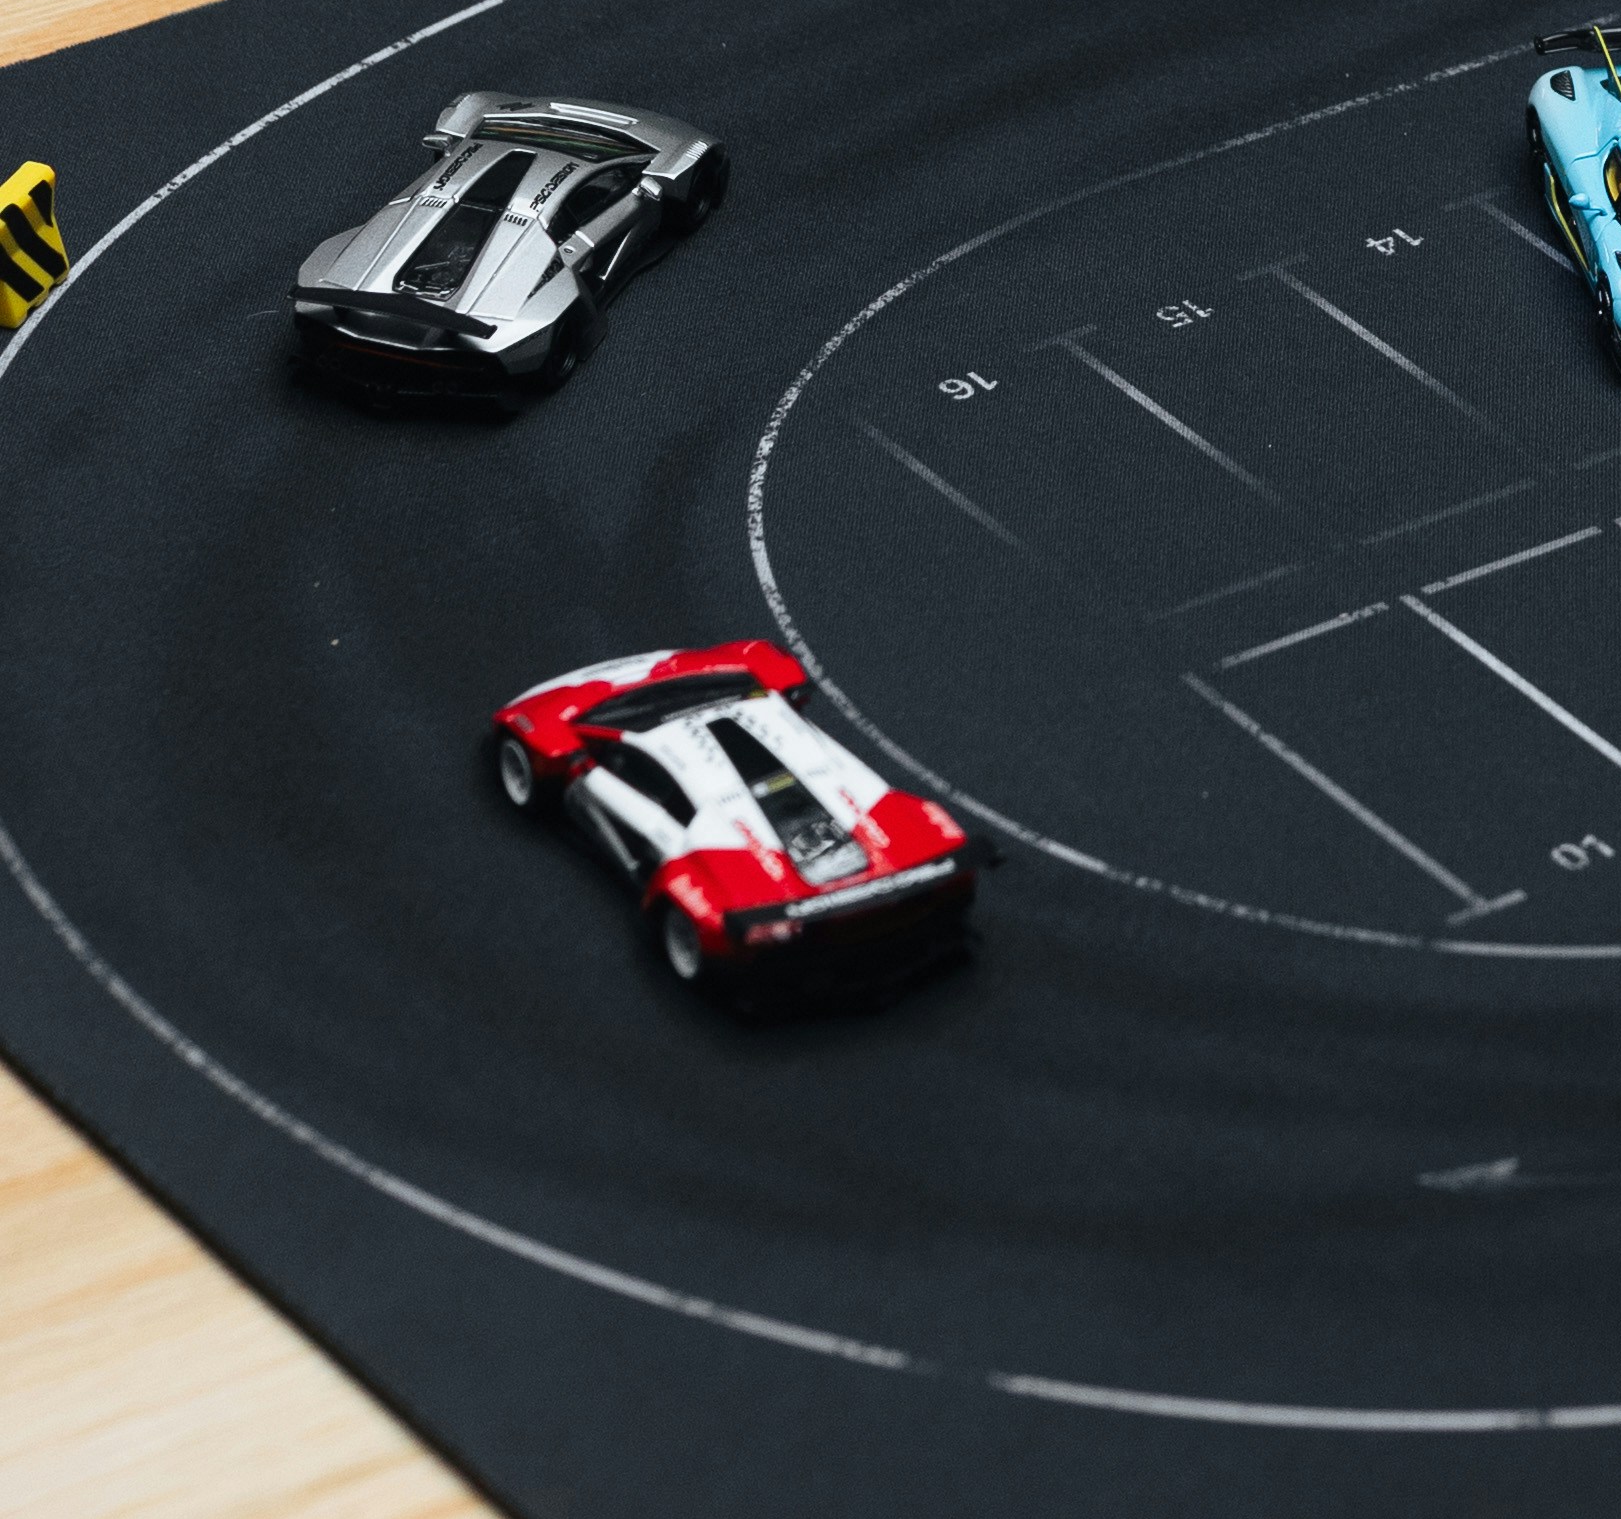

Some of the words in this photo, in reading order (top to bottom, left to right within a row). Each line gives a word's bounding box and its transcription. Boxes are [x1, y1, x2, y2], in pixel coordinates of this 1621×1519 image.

[1366, 227, 1424, 256] 14
[1156, 299, 1214, 328] 15
[938, 370, 999, 400] 16
[1550, 832, 1616, 873] 01
